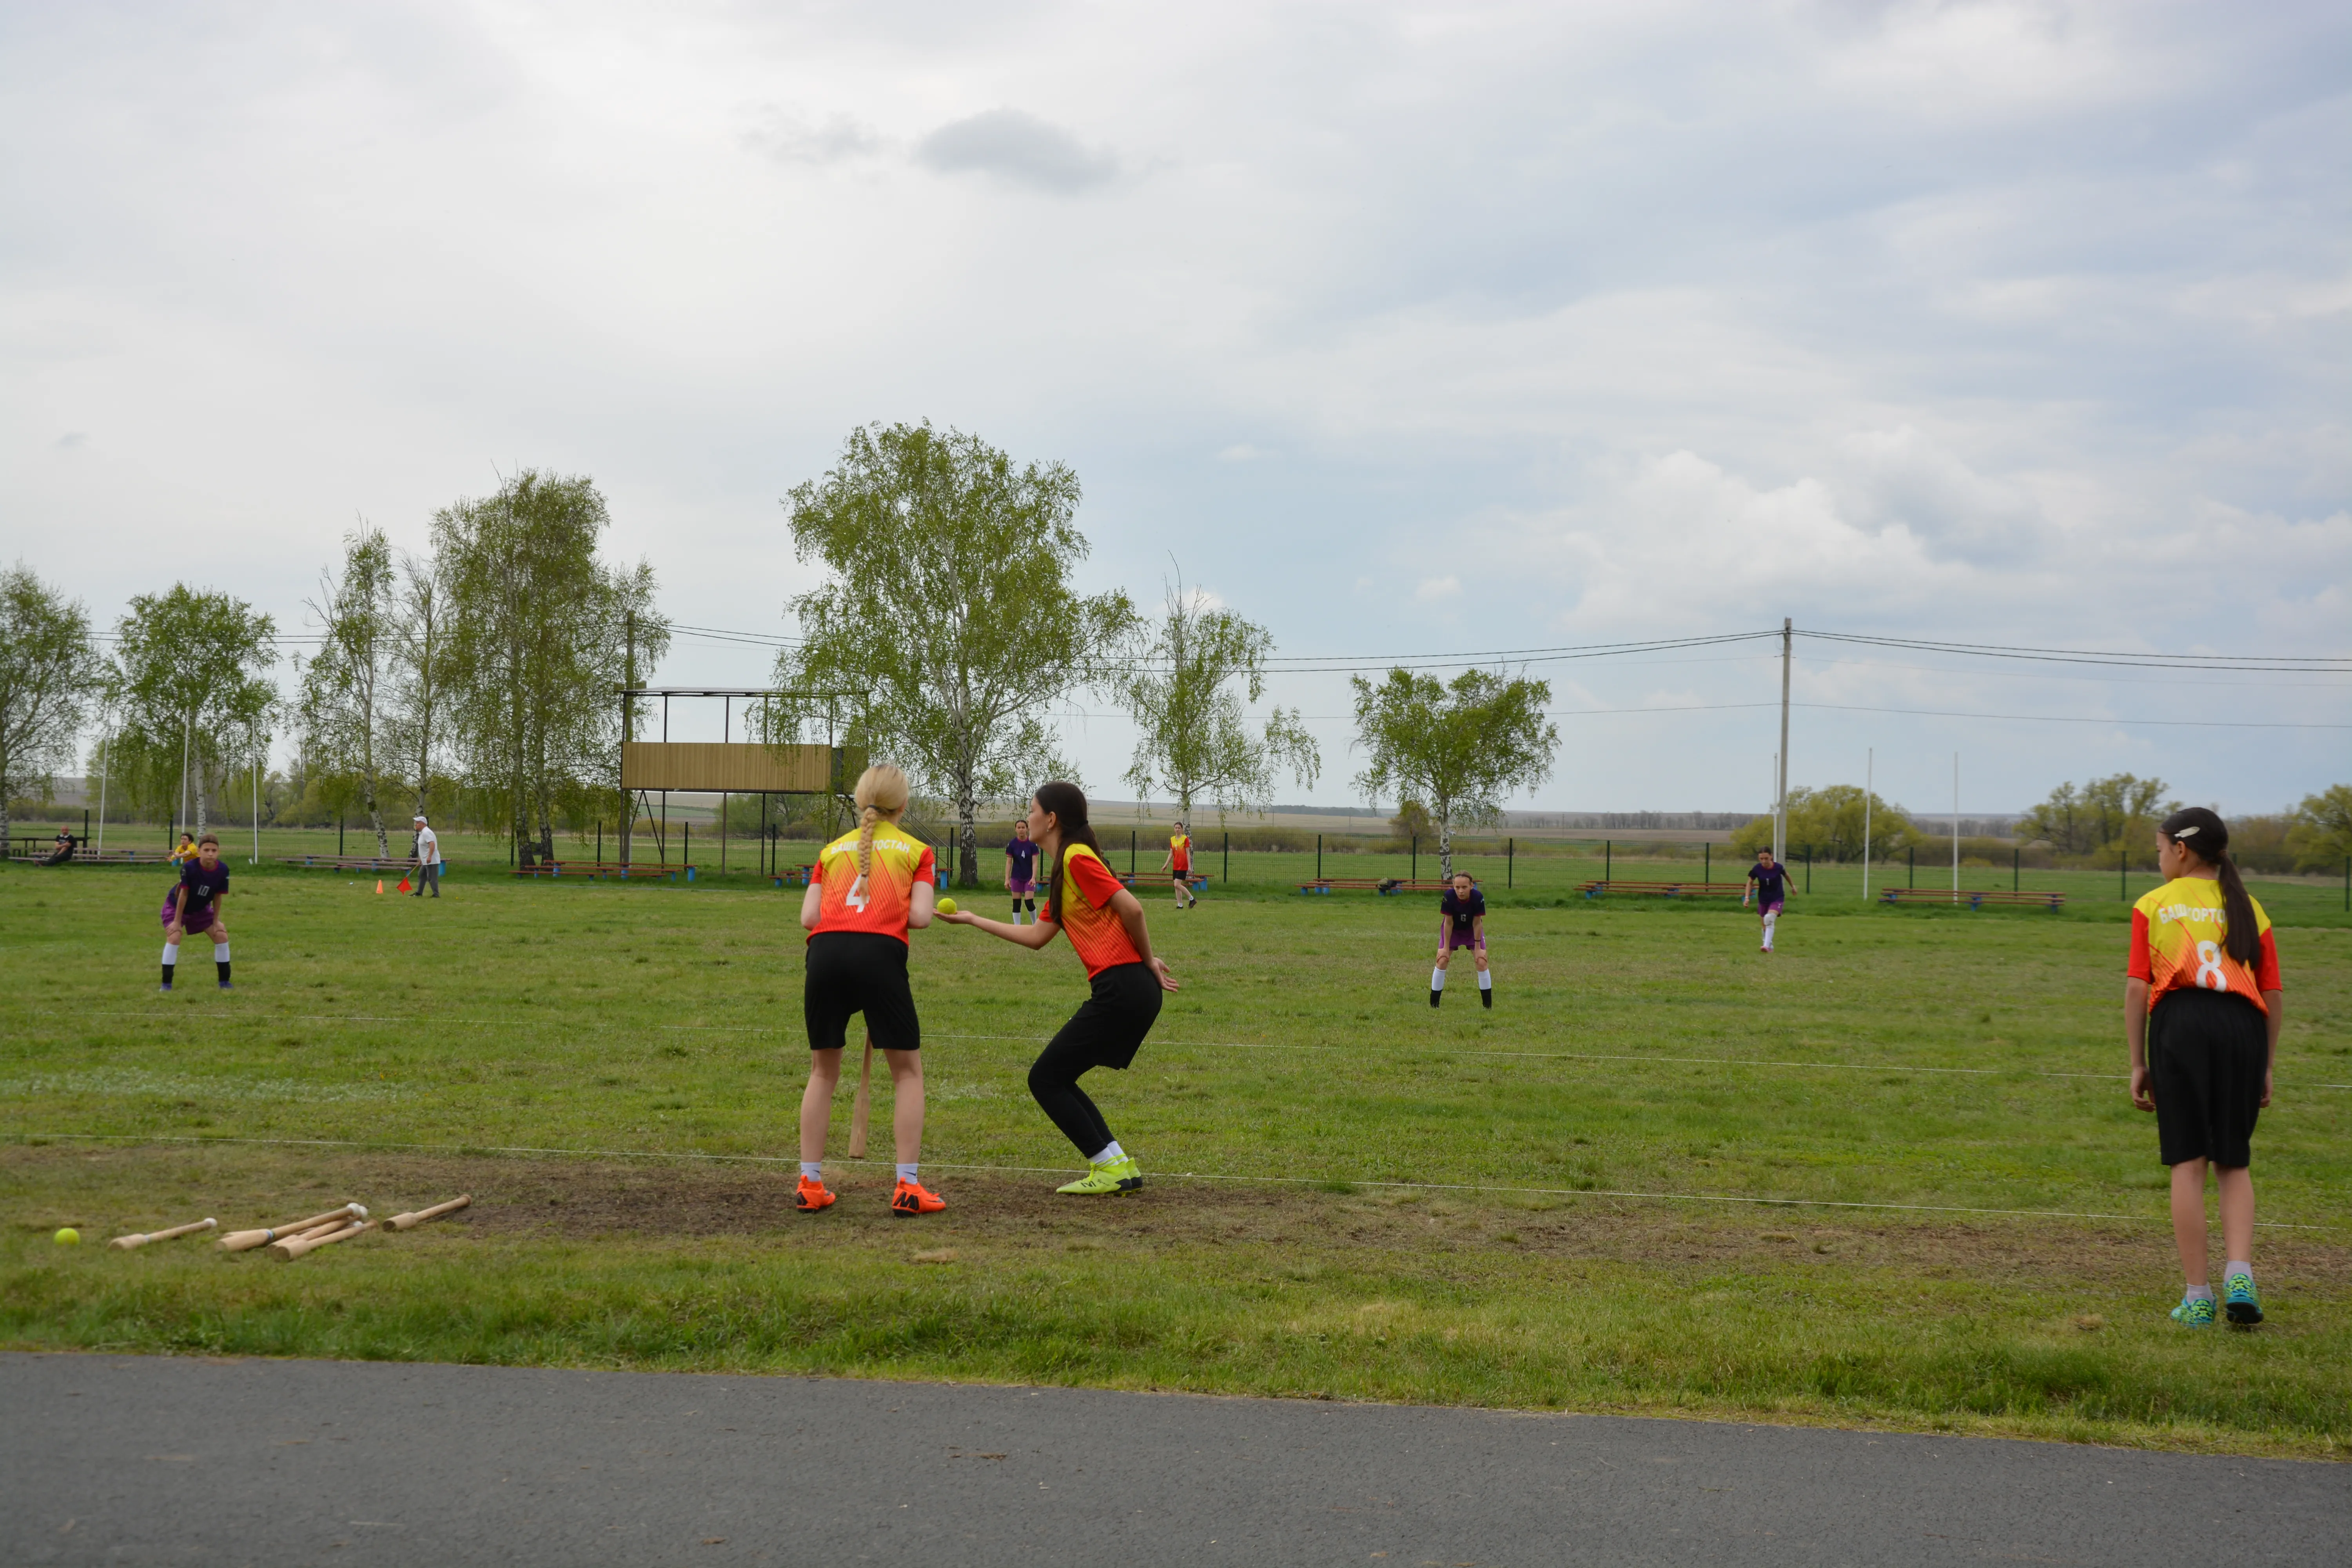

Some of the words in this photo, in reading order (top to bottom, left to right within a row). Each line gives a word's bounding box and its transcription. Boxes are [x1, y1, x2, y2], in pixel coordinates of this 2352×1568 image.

[831, 839, 911, 854] БАШКТОСТАН
[1021, 850, 1025, 859] 4
[198, 884, 210, 897] 10
[846, 873, 870, 913] 4
[2196, 940, 2227, 993] 8
